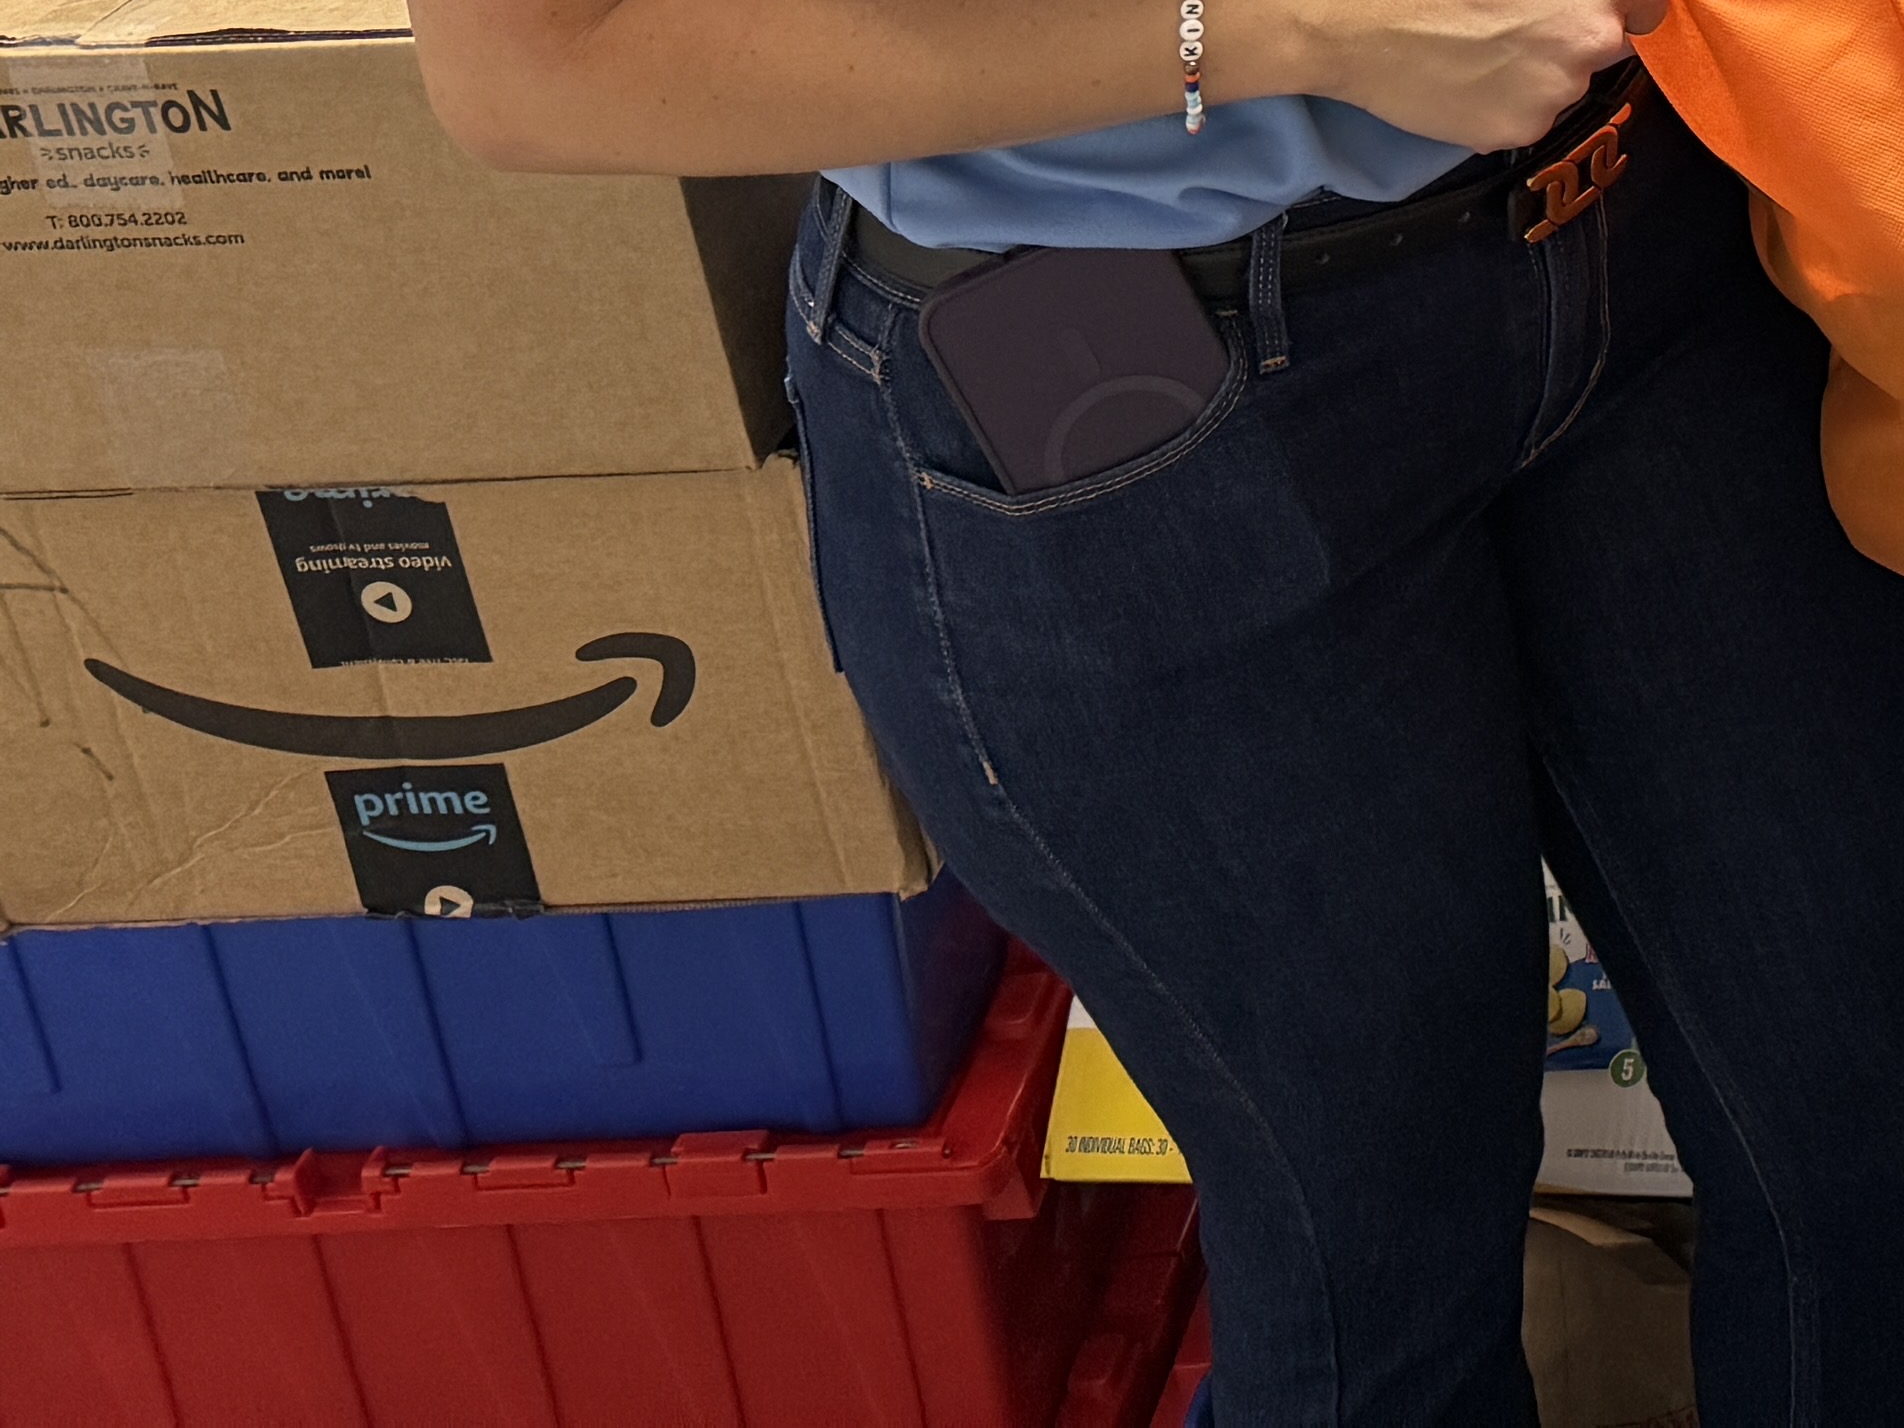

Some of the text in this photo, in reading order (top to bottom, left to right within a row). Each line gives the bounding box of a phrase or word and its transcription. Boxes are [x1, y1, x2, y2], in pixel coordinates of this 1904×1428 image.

[55, 142, 136, 161] snacks
[168, 169, 272, 188] healthcare,
[277, 166, 314, 183] and
[68, 211, 188, 229] 800.754.2202
[0, 231, 245, 253] www.darlingtonsnacks.com
[295, 555, 452, 575] video streaming
[353, 781, 491, 827] prime
